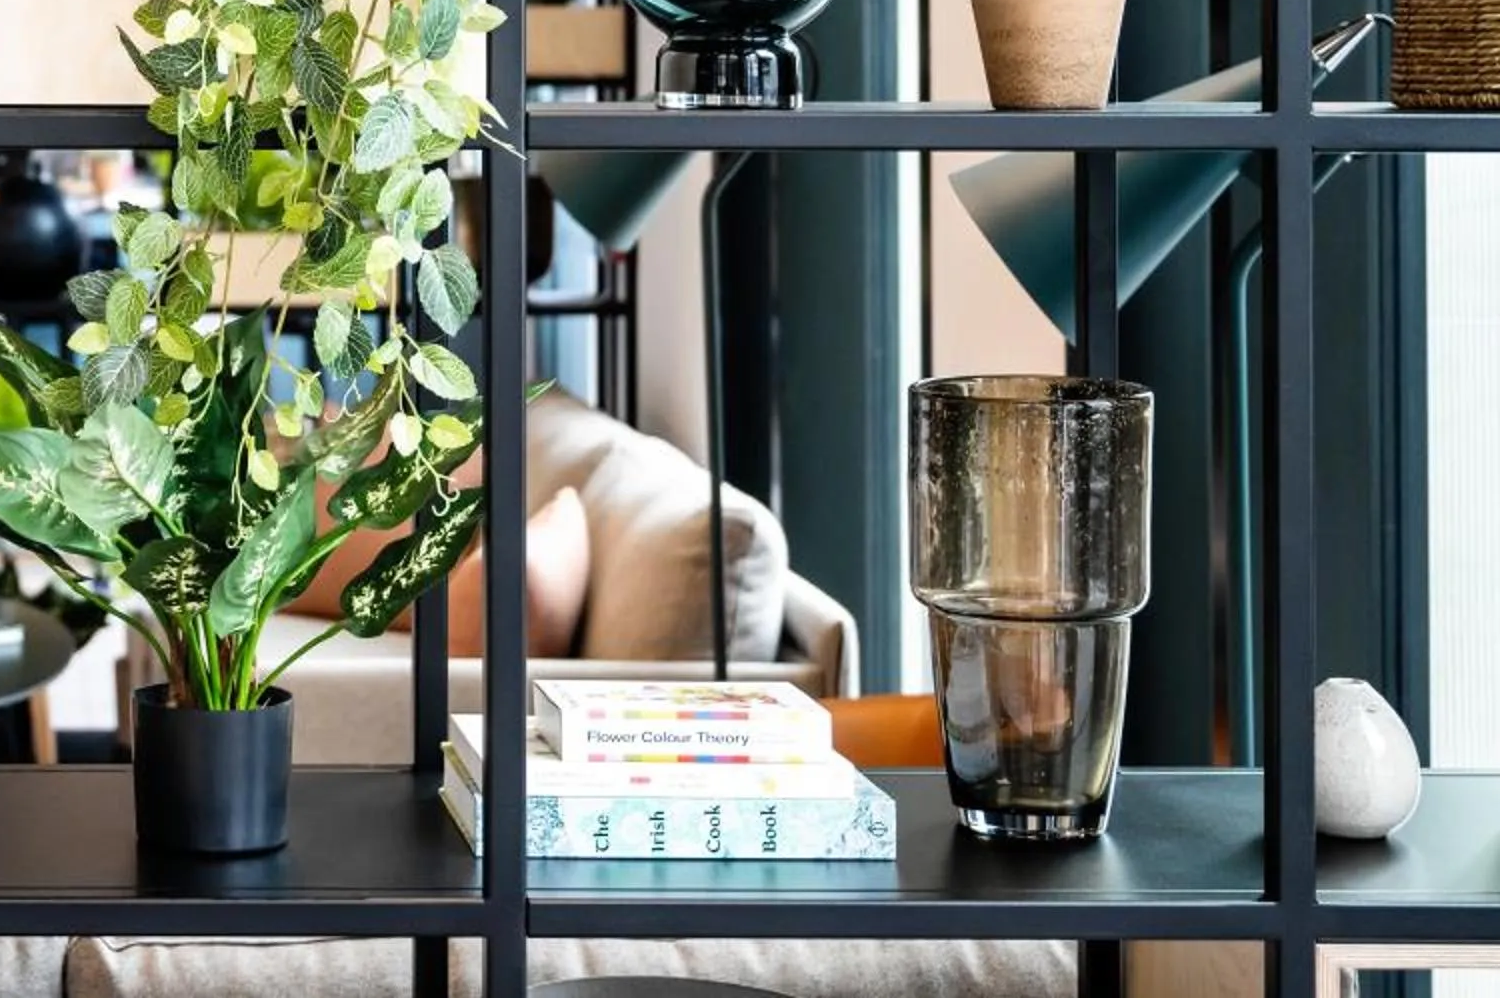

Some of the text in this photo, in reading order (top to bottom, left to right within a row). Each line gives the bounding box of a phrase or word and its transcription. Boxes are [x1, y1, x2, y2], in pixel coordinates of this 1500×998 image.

[587, 730, 636, 743] Flower
[641, 730, 692, 744] Colour
[696, 730, 750, 746] Theory
[593, 805, 777, 853] The Irish Cook Book
